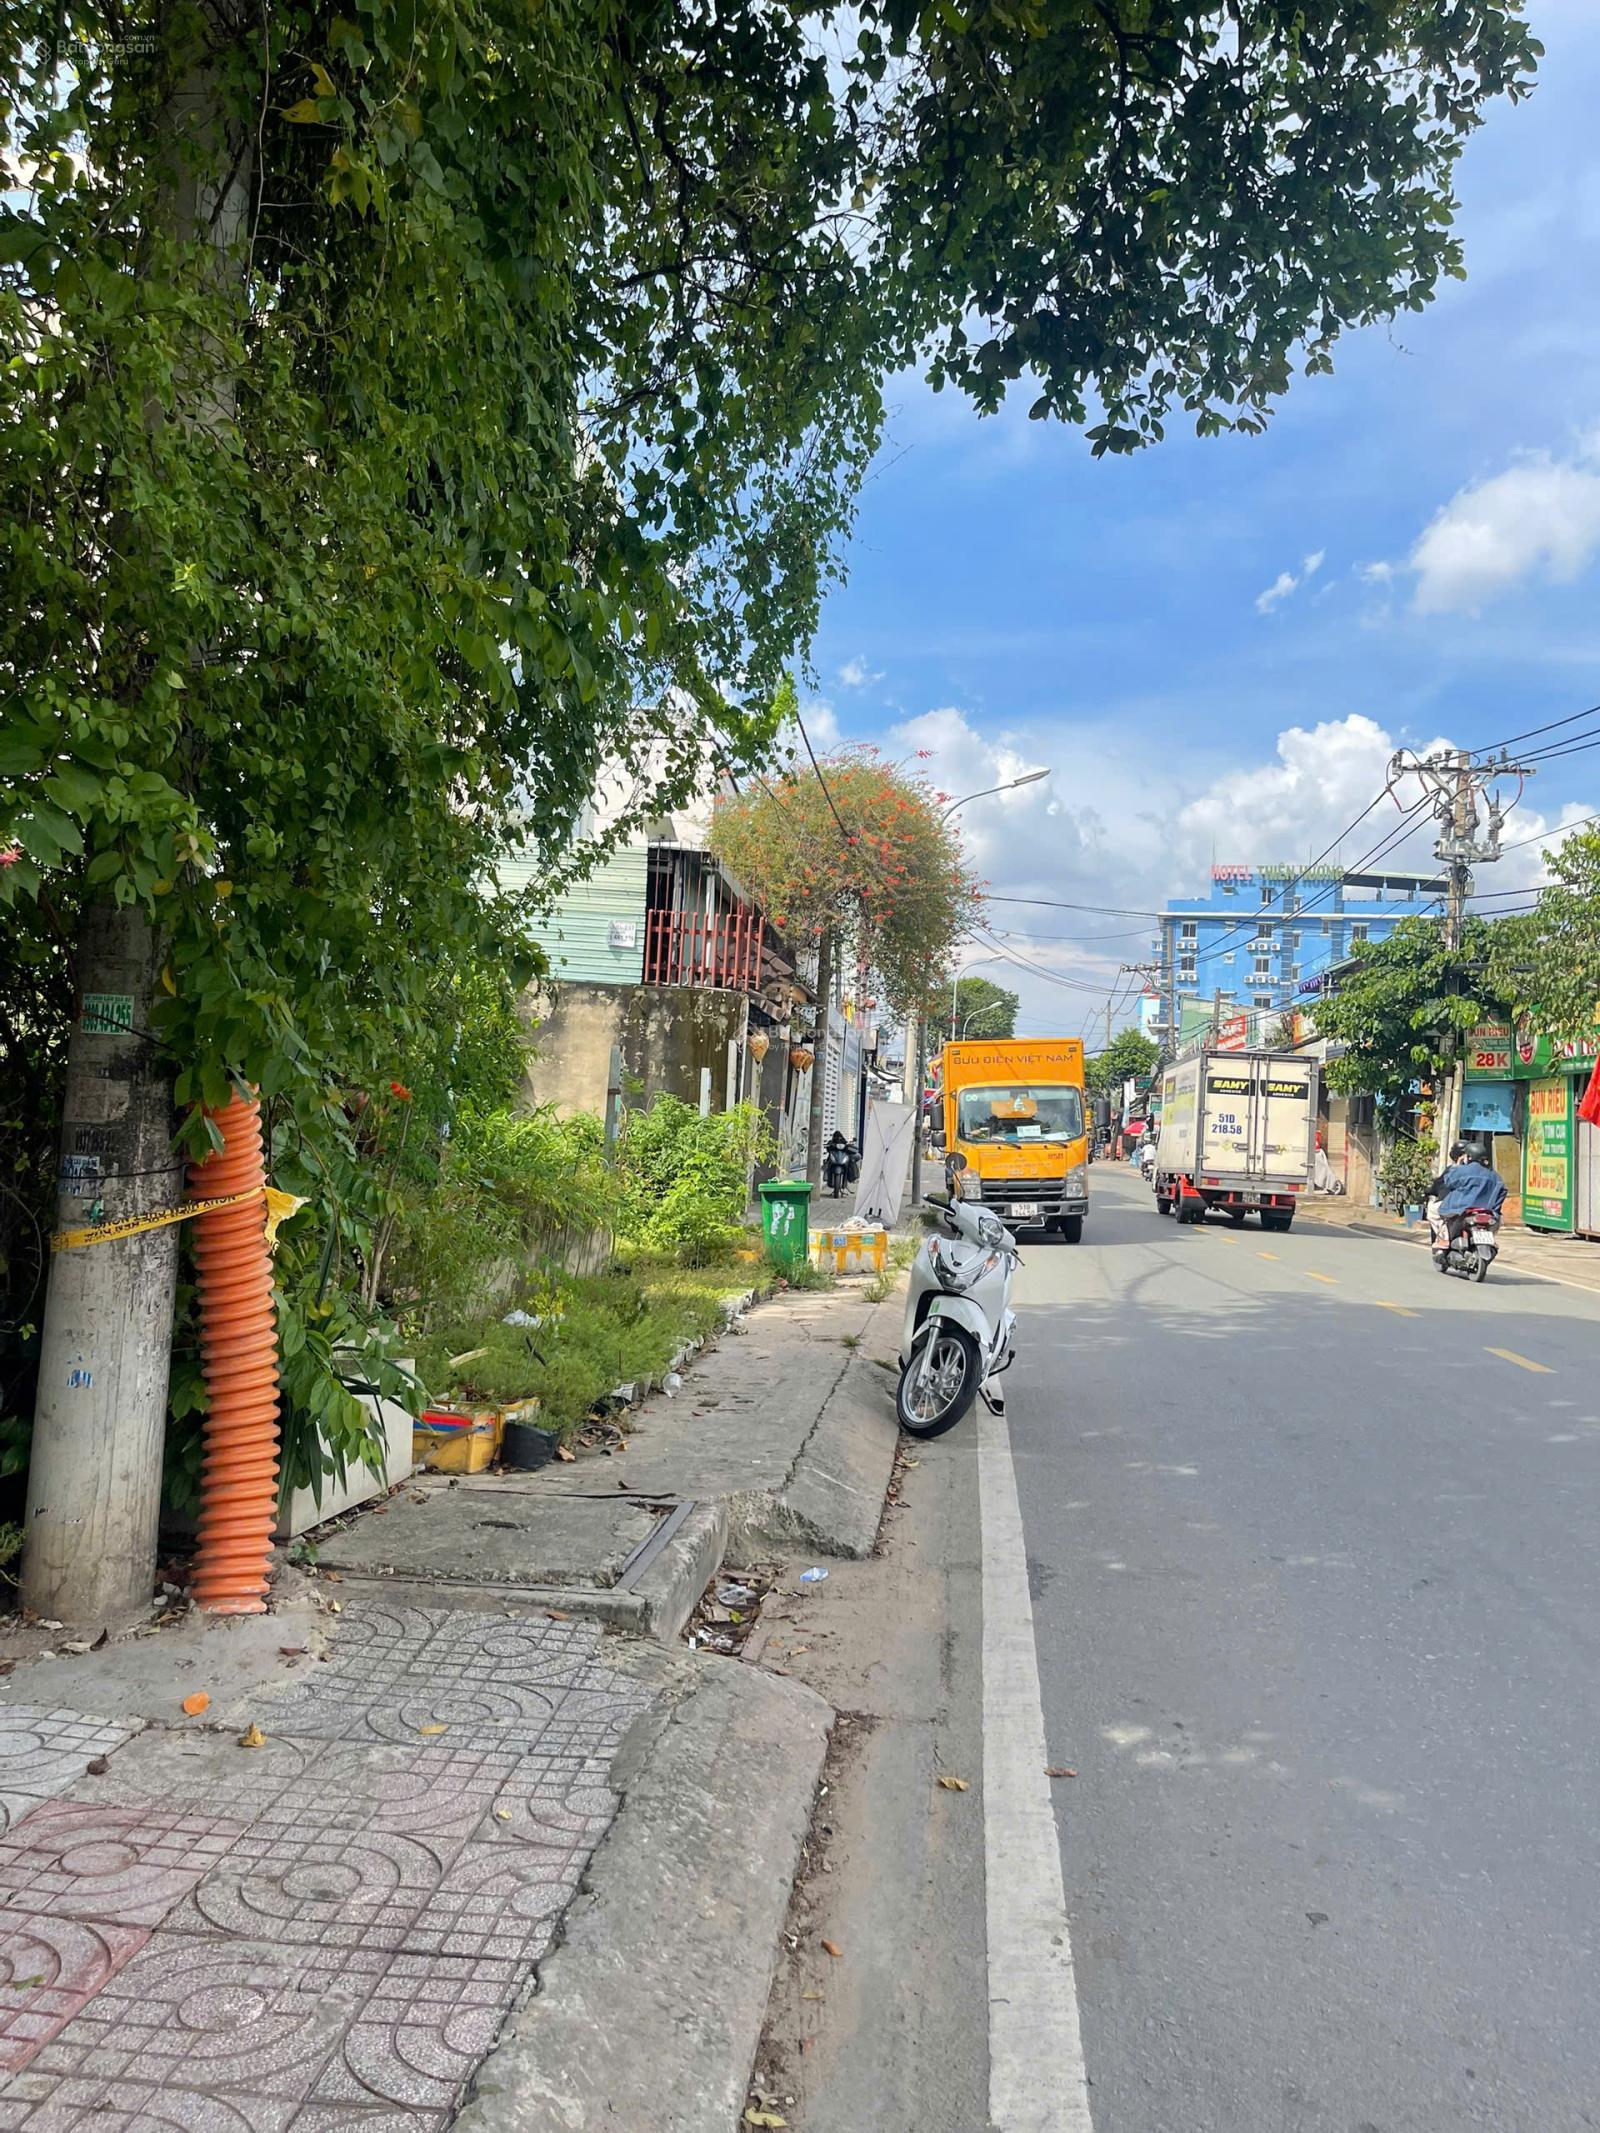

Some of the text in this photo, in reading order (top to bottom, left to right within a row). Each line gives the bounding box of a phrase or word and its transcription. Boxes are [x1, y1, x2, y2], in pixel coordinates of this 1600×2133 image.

[1210, 863, 1252, 881] HOTEL
[1046, 1054, 1074, 1063] NAM
[1212, 1079, 1249, 1090] SAMY
[1218, 1113, 1236, 1123] 51D
[1211, 1123, 1243, 1135] 218.58
